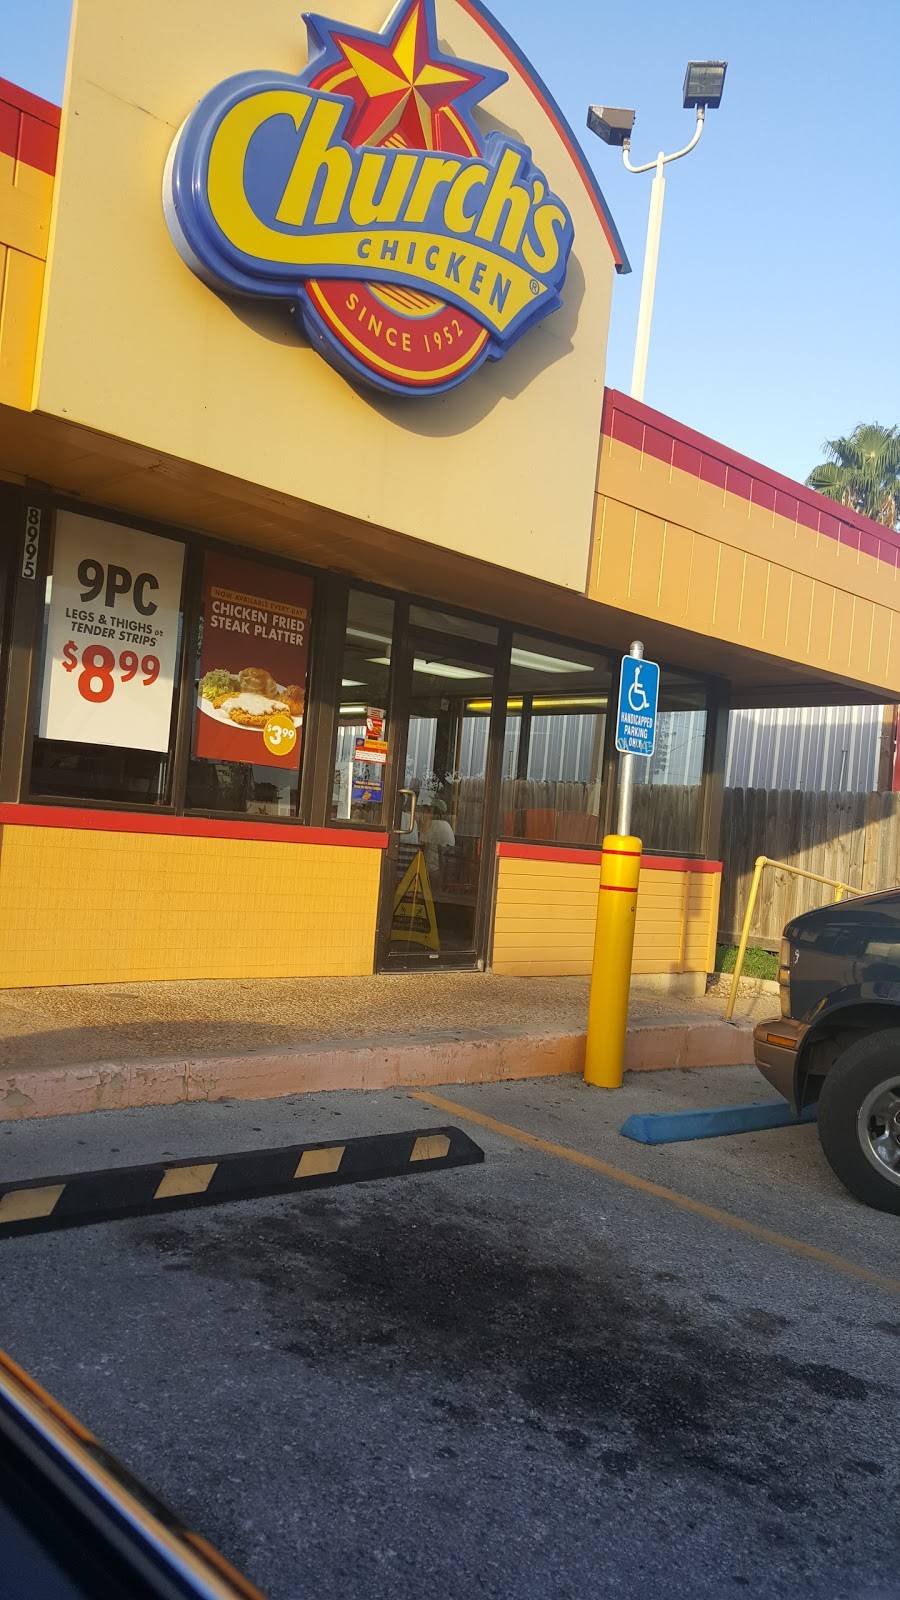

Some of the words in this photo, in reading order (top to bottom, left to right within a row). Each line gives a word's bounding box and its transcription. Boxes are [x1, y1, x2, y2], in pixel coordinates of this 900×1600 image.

[207, 90, 566, 274] Church's
[357, 238, 512, 314] CHICKEN
[345, 293, 412, 353] SINCE
[424, 319, 464, 353] 1952
[23, 508, 39, 578] 8995
[78, 559, 160, 616] 9PC
[65, 608, 95, 622] LEGS
[98, 614, 107, 625] &
[110, 616, 152, 635] THIGHS
[210, 615, 250, 635] STEAK
[254, 625, 304, 646] PLATTER
[212, 601, 268, 624] CHICKEN
[272, 614, 305, 632] FRIED
[71, 621, 115, 639] TENDER
[119, 631, 157, 647] STRIPS
[621, 712, 653, 728] HANDICAPPED
[624, 724, 648, 739] PARKING
